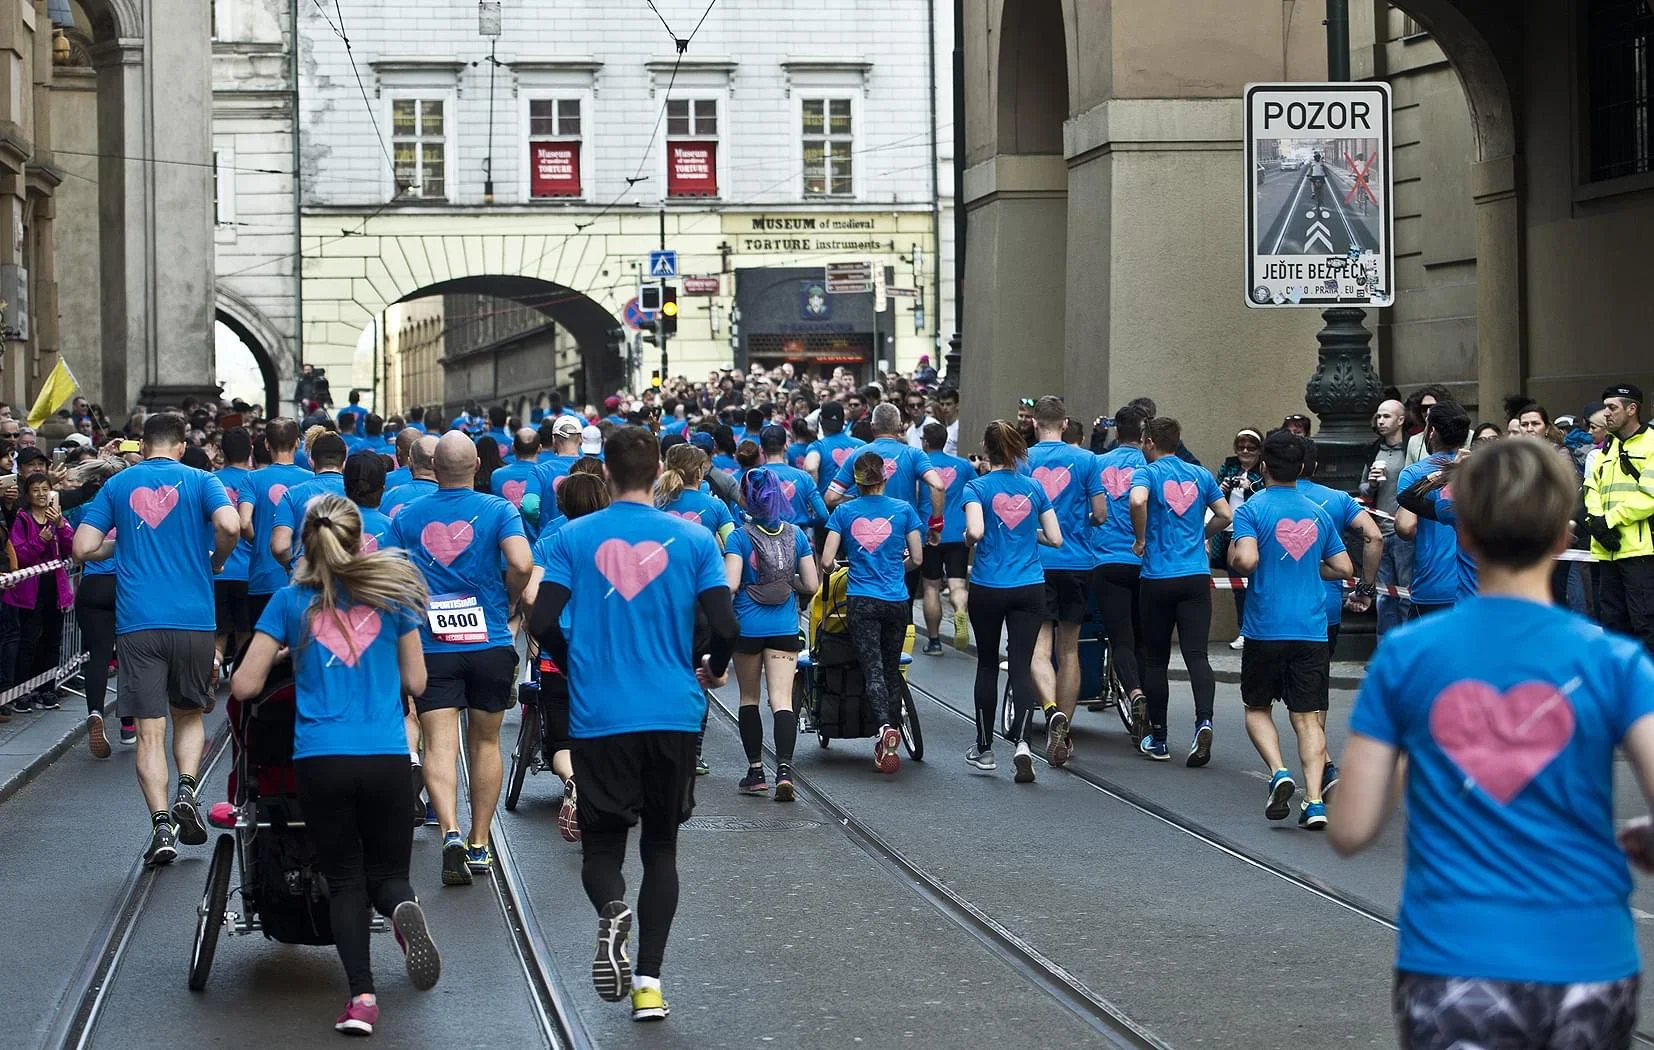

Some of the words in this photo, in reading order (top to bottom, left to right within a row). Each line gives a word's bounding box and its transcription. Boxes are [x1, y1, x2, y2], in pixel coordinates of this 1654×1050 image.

[1264, 101, 1371, 130] POZOR
[752, 218, 816, 230] MUSEUM
[819, 219, 830, 229] of
[832, 219, 875, 229] medieval
[745, 239, 810, 250] TORTURE
[815, 239, 881, 250] instruments
[1262, 260, 1303, 279] JEĎTE
[1308, 259, 1375, 279] BEZPEČN
[1286, 286, 1309, 295] CYO
[437, 613, 478, 627] 8400
